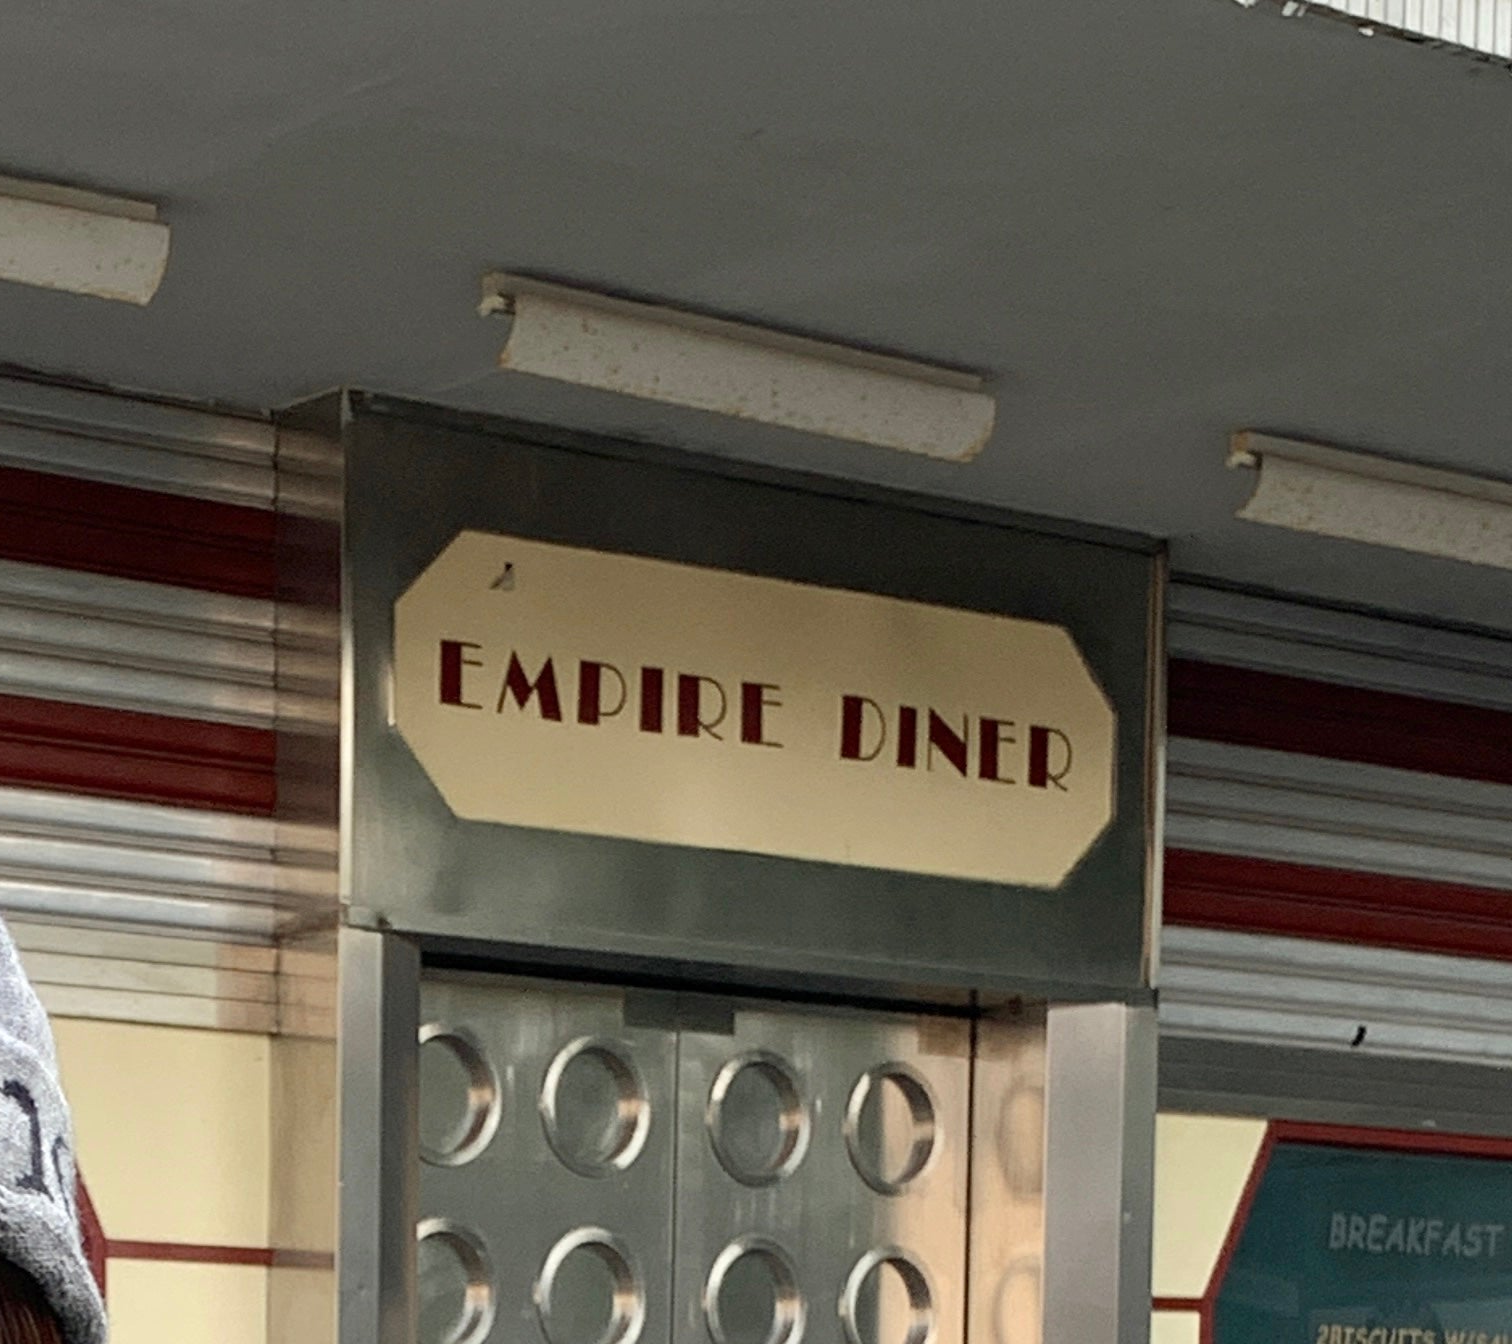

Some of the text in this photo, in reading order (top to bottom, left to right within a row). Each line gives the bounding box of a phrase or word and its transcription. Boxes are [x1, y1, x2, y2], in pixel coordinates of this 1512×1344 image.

[439, 639, 1073, 793] EMPIRE DINER
[1329, 1211, 1505, 1258] BREAKFAST
